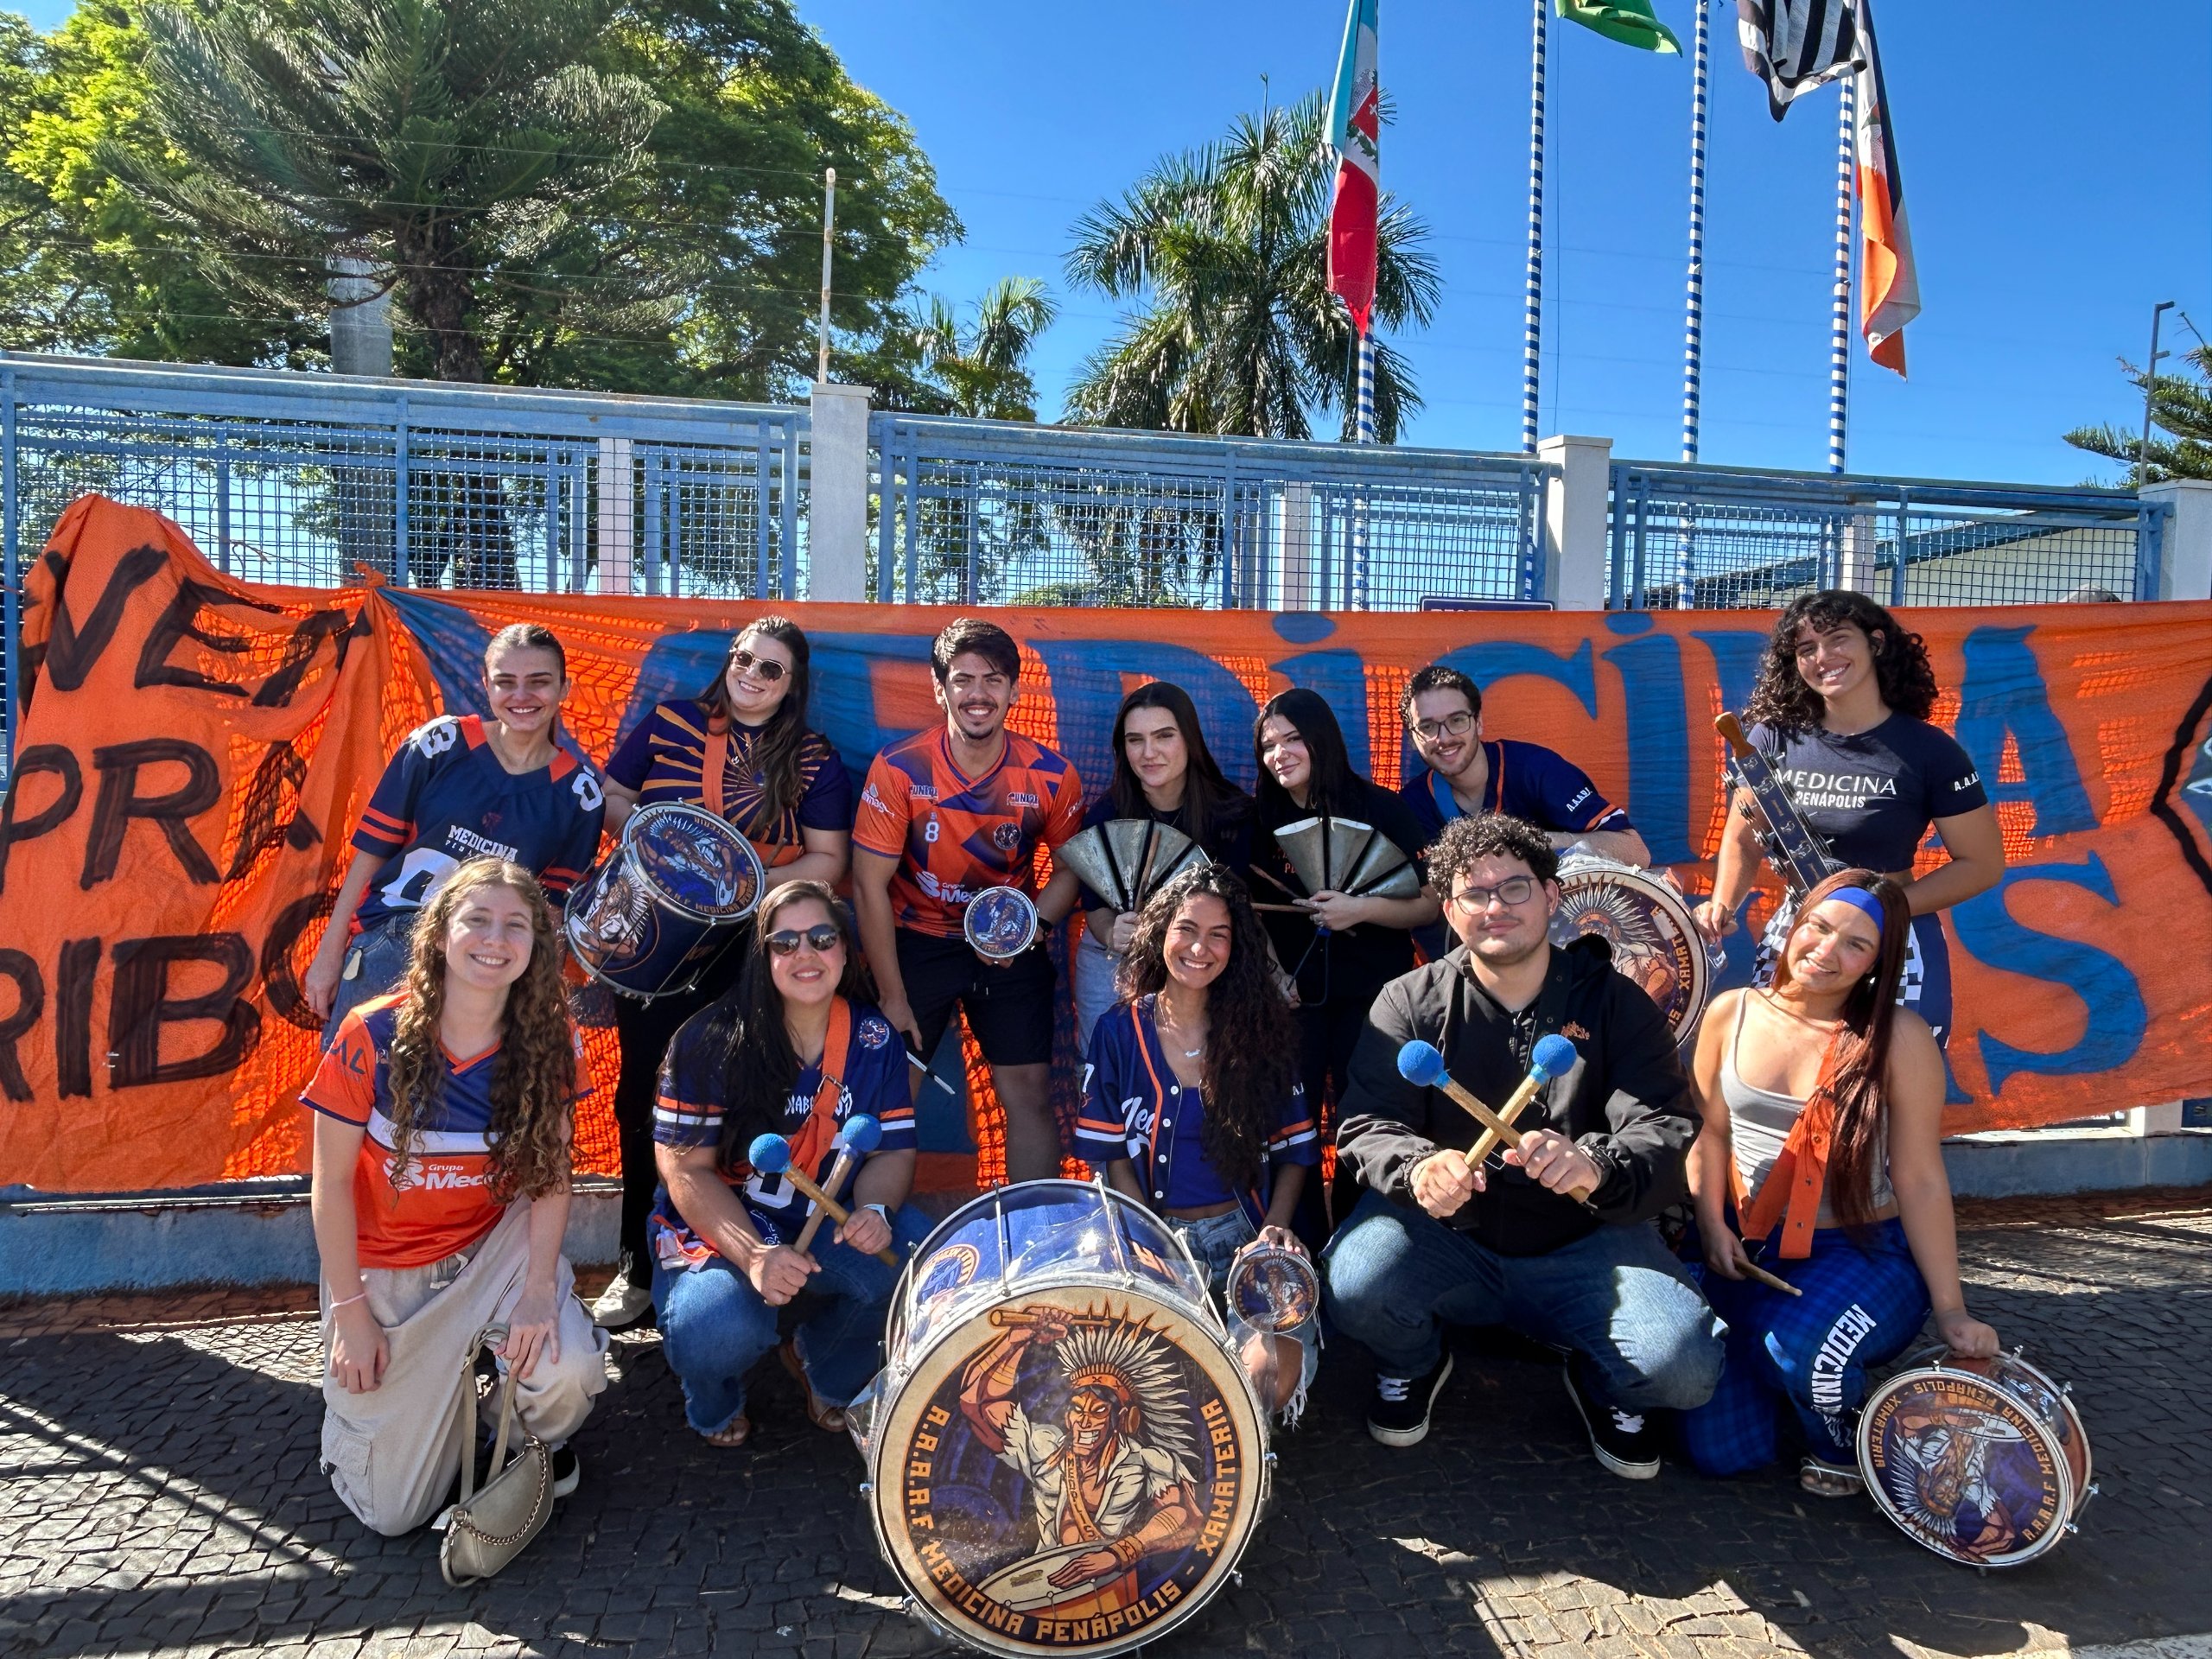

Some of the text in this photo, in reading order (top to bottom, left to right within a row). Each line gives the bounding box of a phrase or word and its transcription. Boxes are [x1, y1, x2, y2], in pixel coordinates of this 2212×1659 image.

[1774, 767, 1897, 796] MEDICINA
[1795, 791, 1866, 809] PENÁPOLIS
[448, 824, 518, 862] MEDICINA
[925, 821, 940, 843] 8
[1812, 1303, 1877, 1414] MEDICINA
[2002, 1406, 2054, 1475] MEDICINA
[921, 1541, 1025, 1635] MEDICINA
